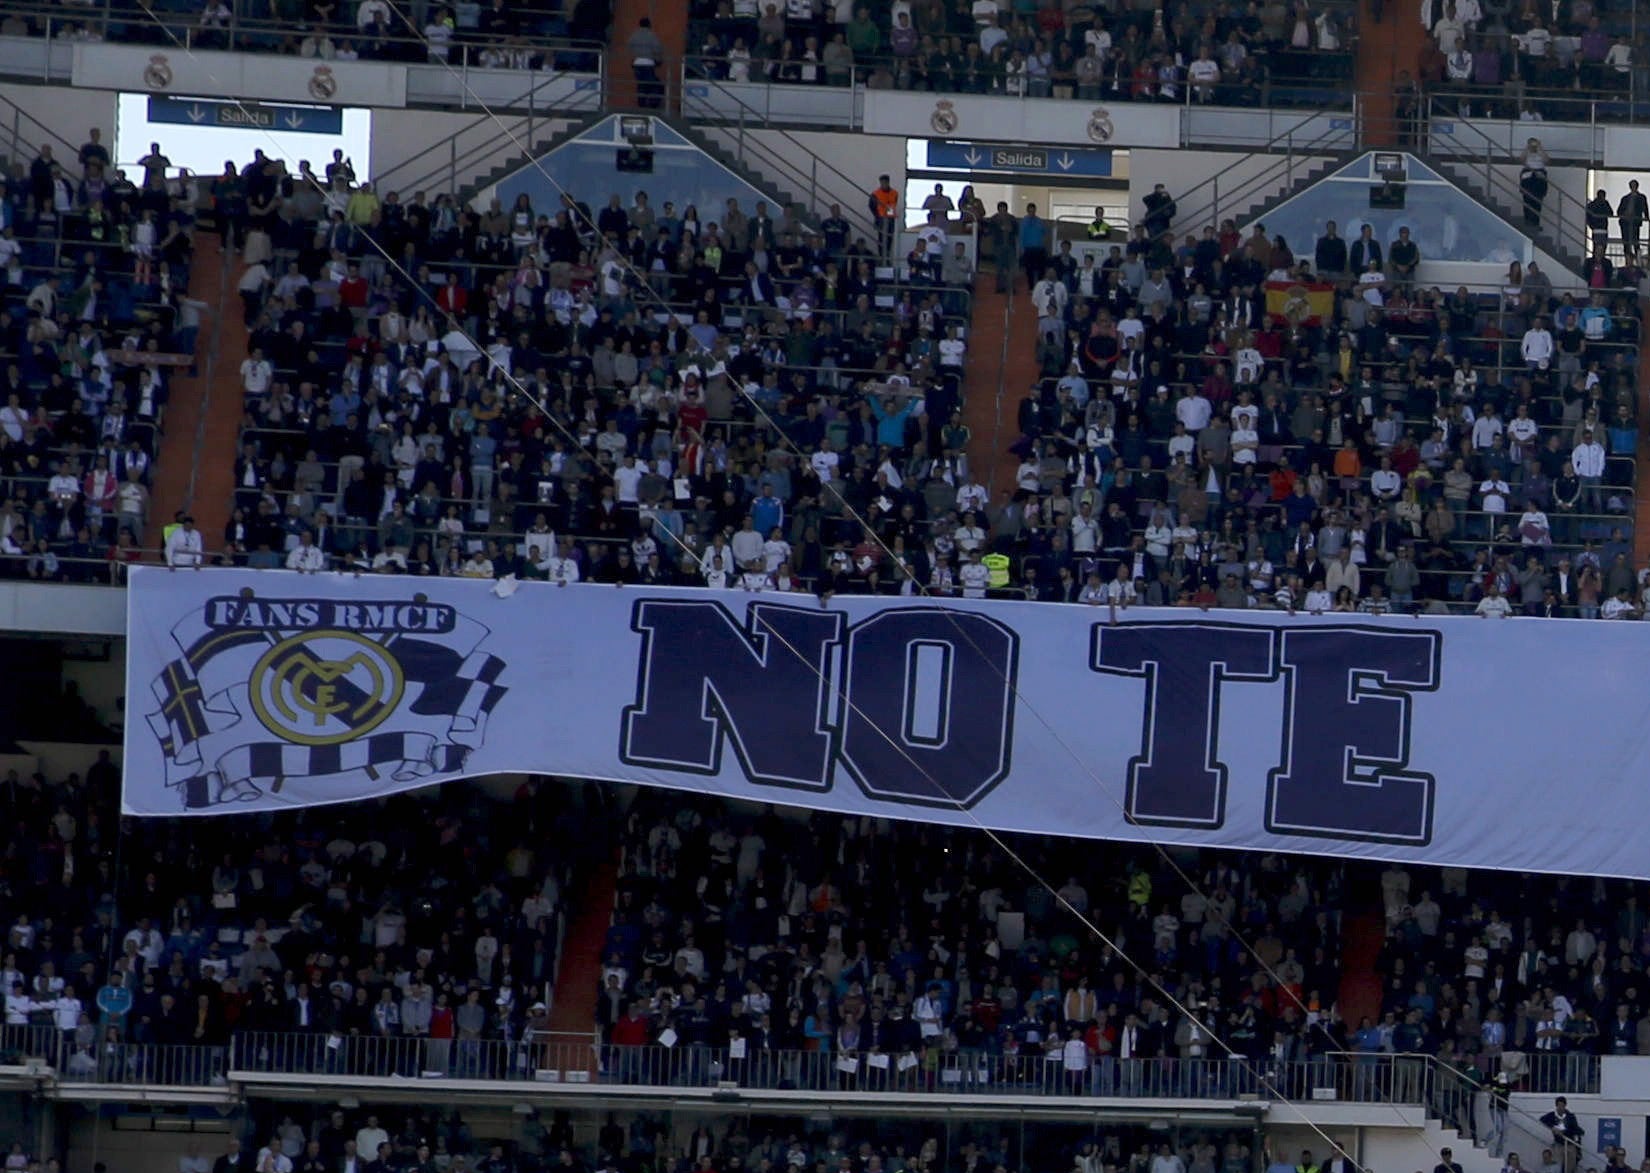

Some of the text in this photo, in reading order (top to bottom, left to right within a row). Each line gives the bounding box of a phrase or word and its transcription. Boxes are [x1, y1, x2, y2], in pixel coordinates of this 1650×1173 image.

[221, 107, 269, 126] Salida
[996, 151, 1042, 168] Salida
[213, 600, 452, 632] FANS RMCF
[618, 599, 1443, 847] NO TE
